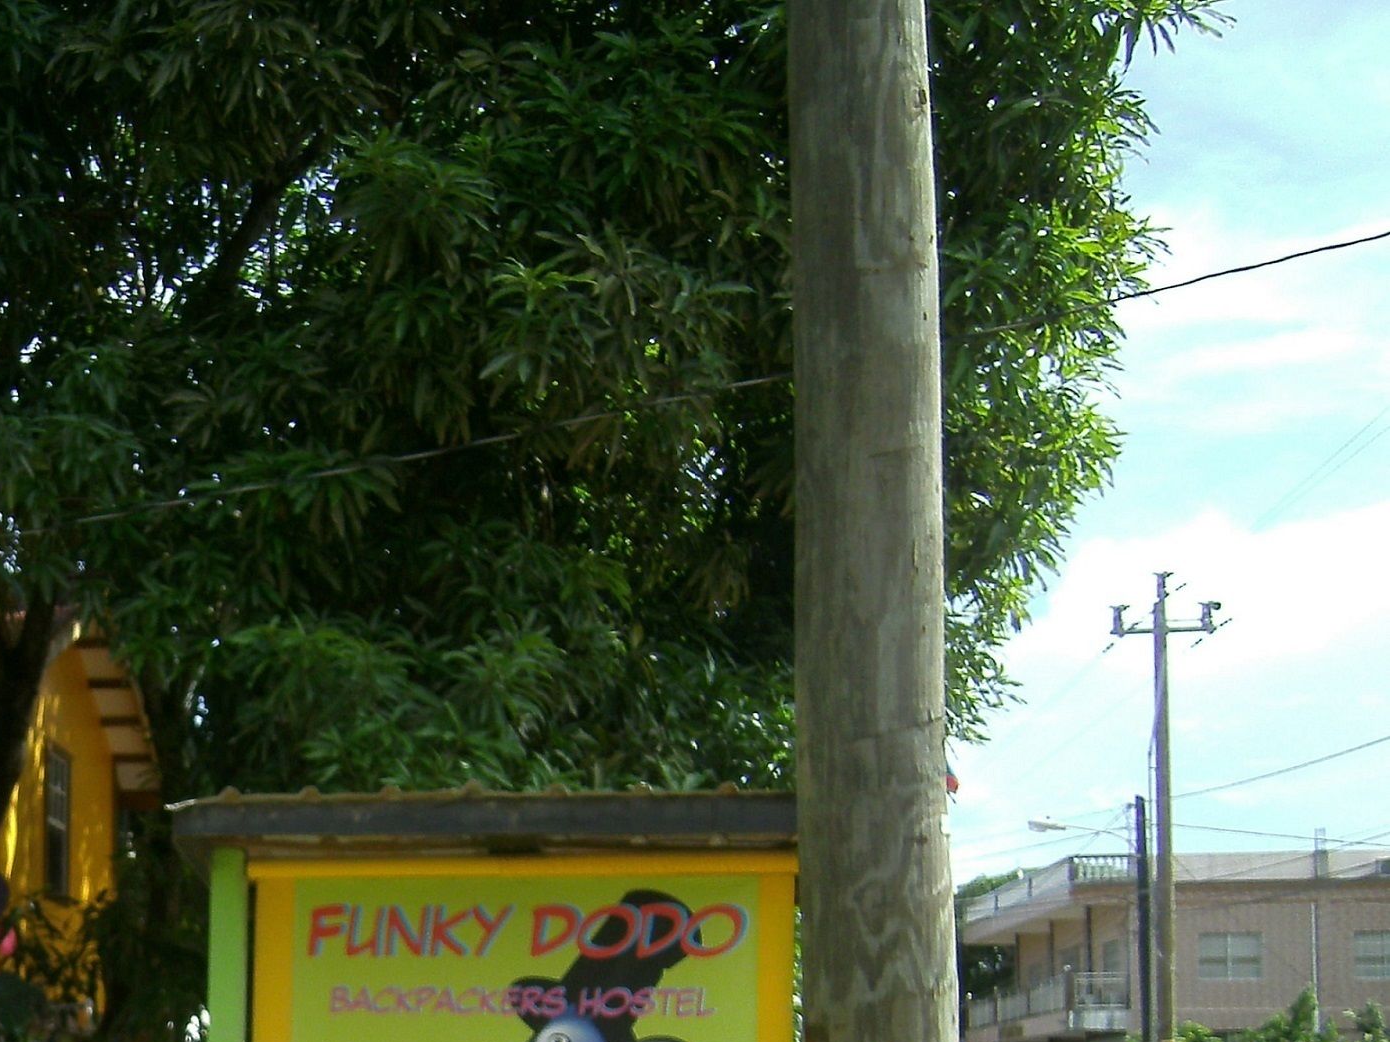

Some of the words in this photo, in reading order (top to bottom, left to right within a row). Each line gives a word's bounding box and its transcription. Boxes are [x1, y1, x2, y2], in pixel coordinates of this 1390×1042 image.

[307, 902, 514, 958] FUNKY
[531, 903, 750, 959] DODO
[329, 984, 568, 1018] BACKPACKERS
[577, 985, 717, 1018] HOSTEL
